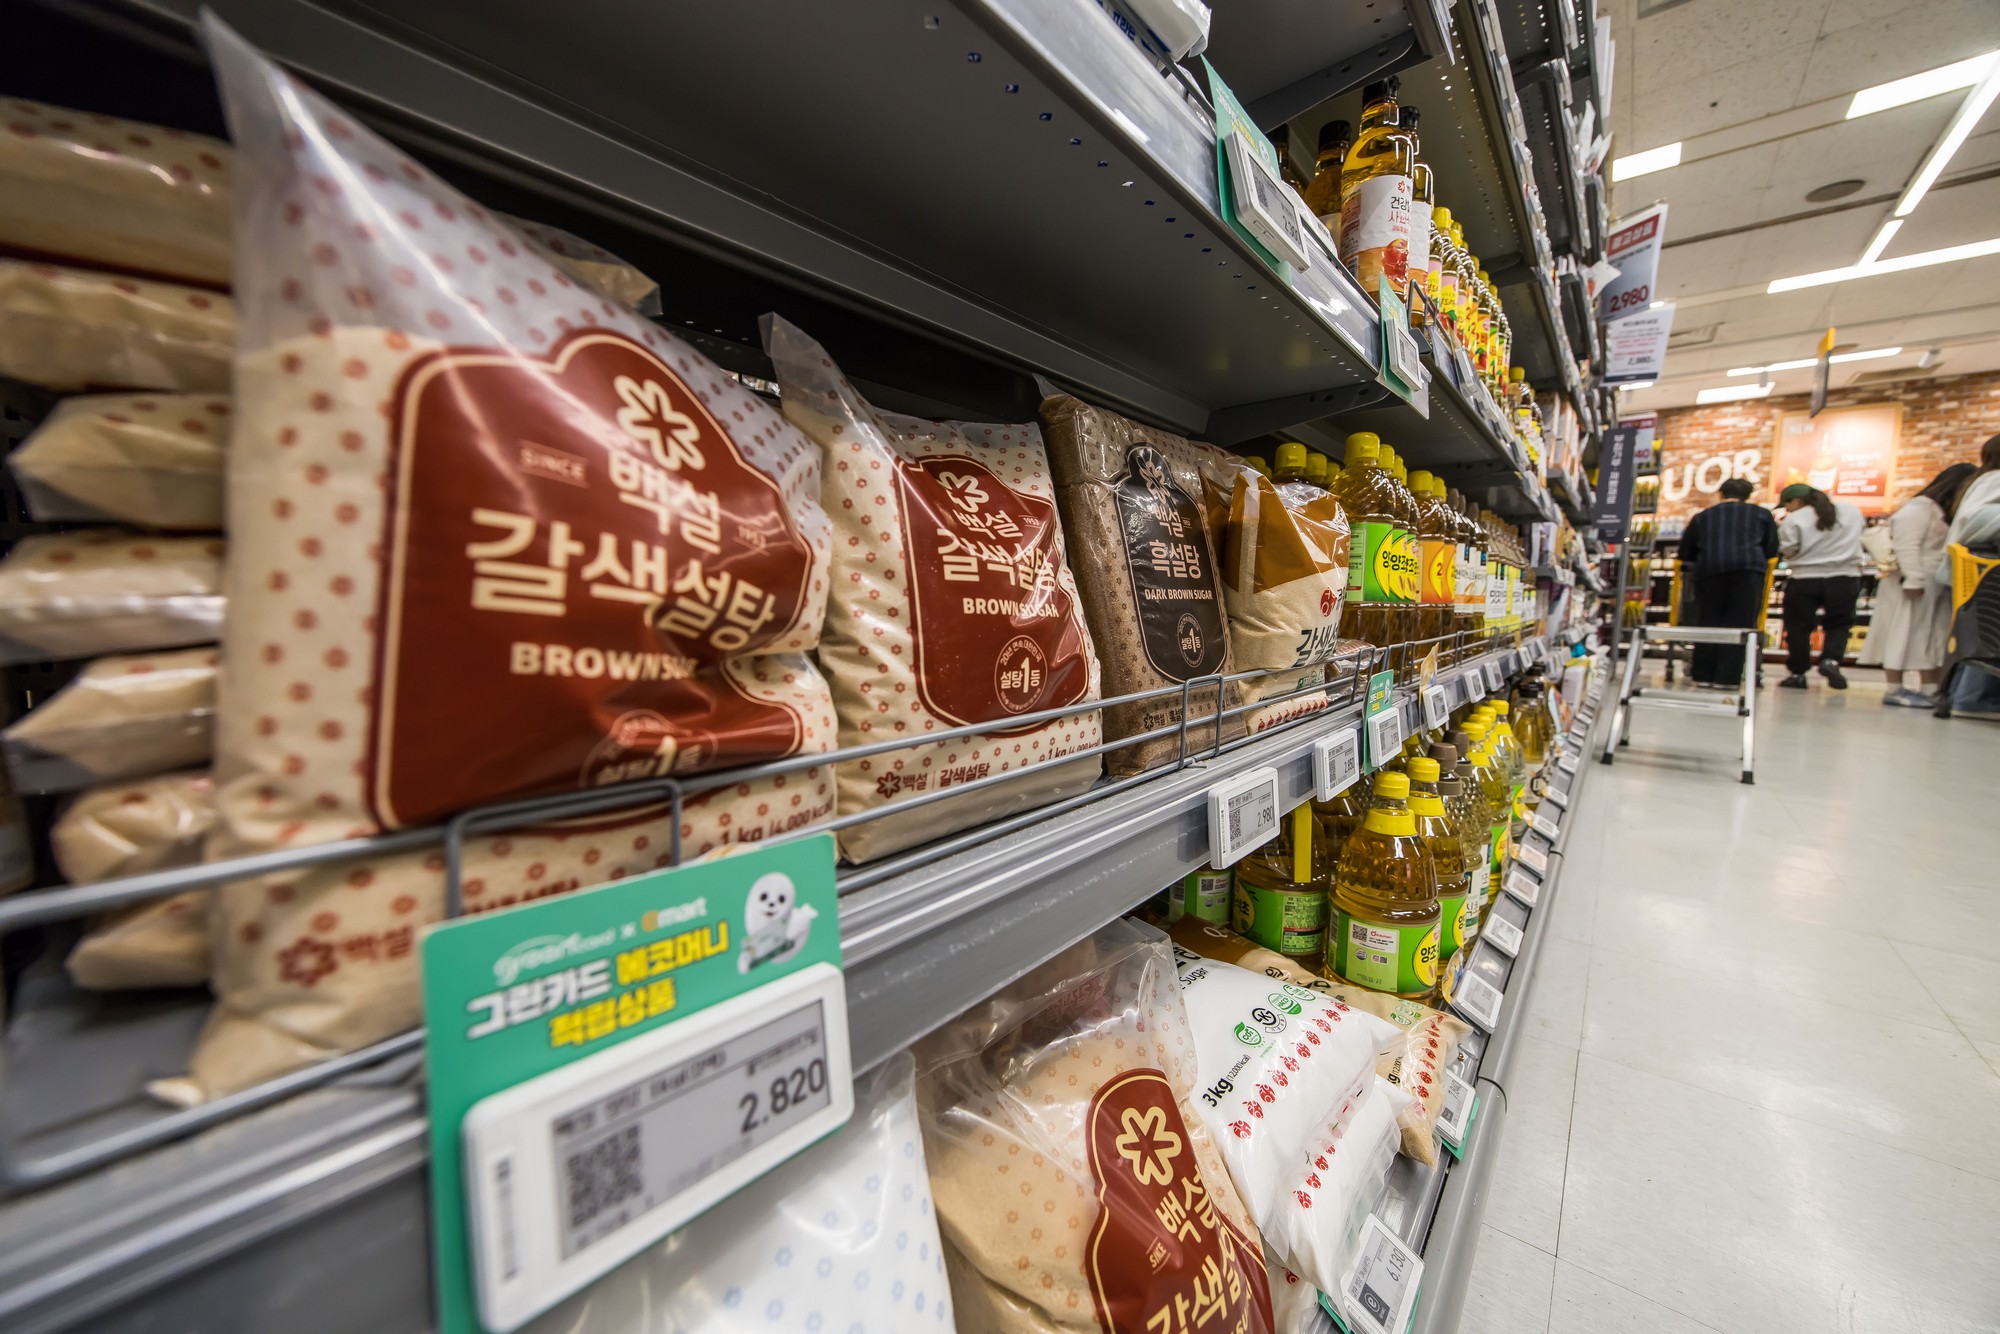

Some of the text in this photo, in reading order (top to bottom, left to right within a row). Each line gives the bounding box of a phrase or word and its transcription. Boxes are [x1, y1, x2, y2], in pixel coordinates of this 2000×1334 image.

[607, 449, 722, 554] 백설
[952, 509, 1024, 540] 백설
[1023, 516, 1040, 527] 1953
[1155, 504, 1185, 538] 백설
[937, 528, 1056, 592] 갈색설탕
[1149, 539, 1202, 579] 흑설탕
[962, 597, 1020, 616] BROWN
[1144, 588, 1213, 600] DARK BROWN SUGAR
[902, 762, 991, 792] 백설 갈색설탕
[465, 919, 730, 1040] 그린카드 에코머니
[1181, 966, 1209, 985] Sugar
[549, 975, 677, 1048] 적립상품
